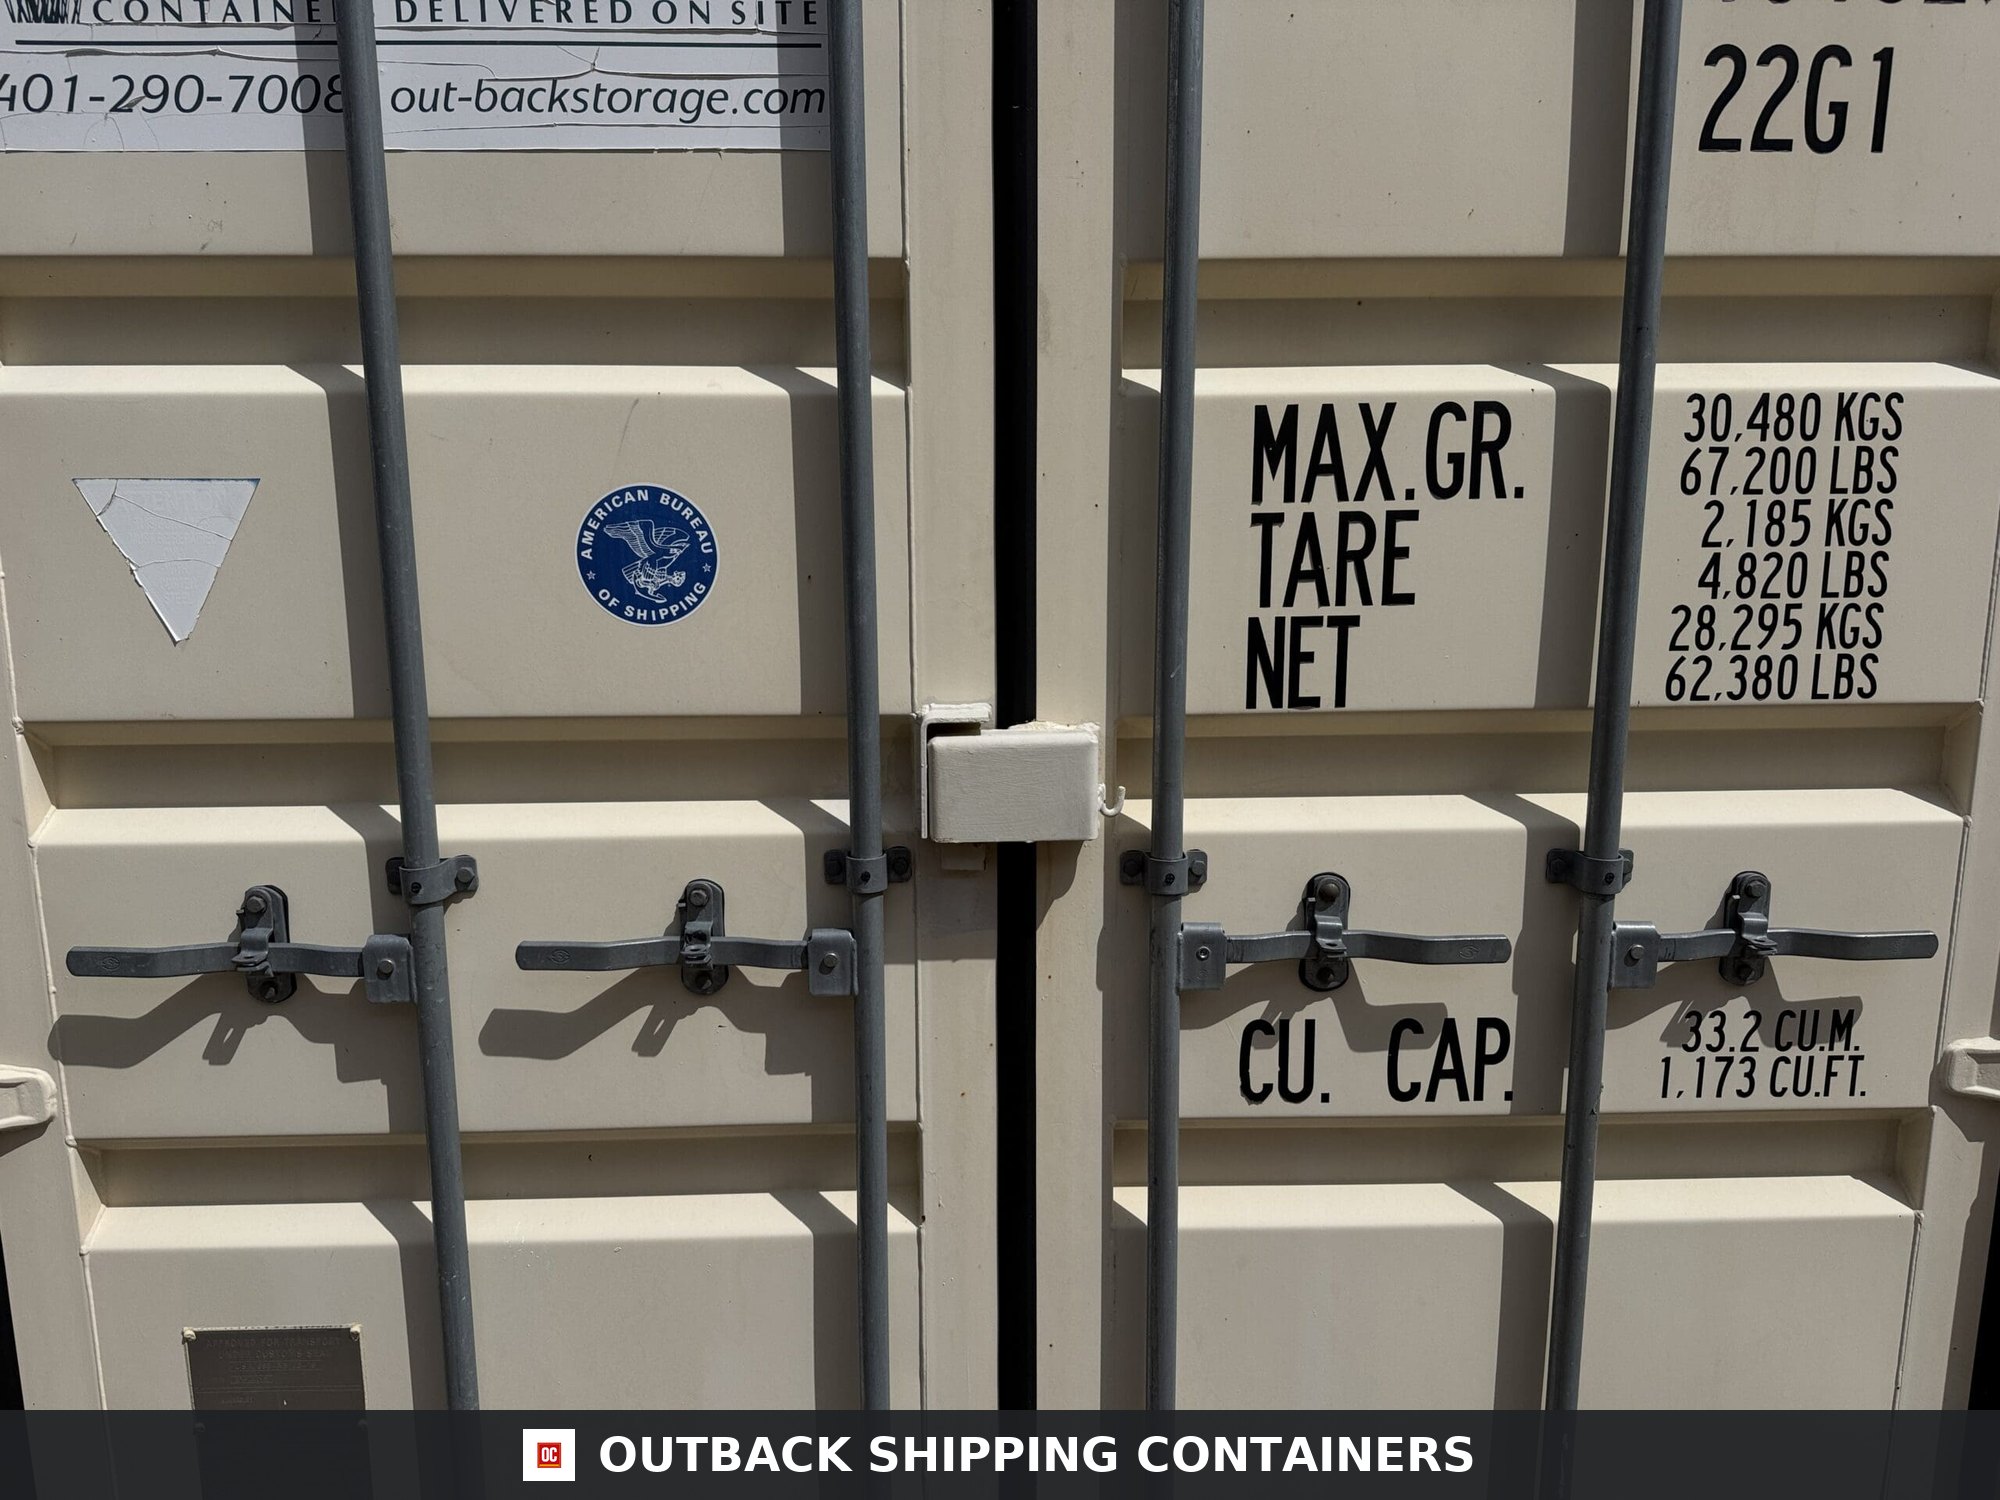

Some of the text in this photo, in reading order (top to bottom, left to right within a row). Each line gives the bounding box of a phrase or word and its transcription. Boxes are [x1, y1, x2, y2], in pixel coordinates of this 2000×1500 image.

[396, 0, 631, 23] DELIVERED
[653, 0, 709, 24] ON
[728, 0, 818, 26] SITE
[390, 79, 825, 124] out-backstorage.com
[1699, 44, 1894, 154] 22G1
[1684, 392, 1903, 442] 30,480 KGS
[1681, 446, 1898, 495] 67,200 LBS
[581, 489, 713, 560] AMERICAN BUREAU
[1702, 499, 1893, 547] 2,185 KGS
[1251, 510, 1419, 608] TARE
[1698, 551, 1889, 599] 4,820 LBS
[598, 582, 706, 621] OF SHIPPING
[1669, 603, 1883, 651] 28,295 KGS
[1246, 615, 1360, 710] NET
[1666, 653, 1878, 701] 62,380 LBS
[1682, 1009, 1860, 1053] 33.2 CU.M.
[1240, 1018, 1513, 1103] CU. CAP.
[1662, 1055, 1864, 1098] 1,173 CU.FT.
